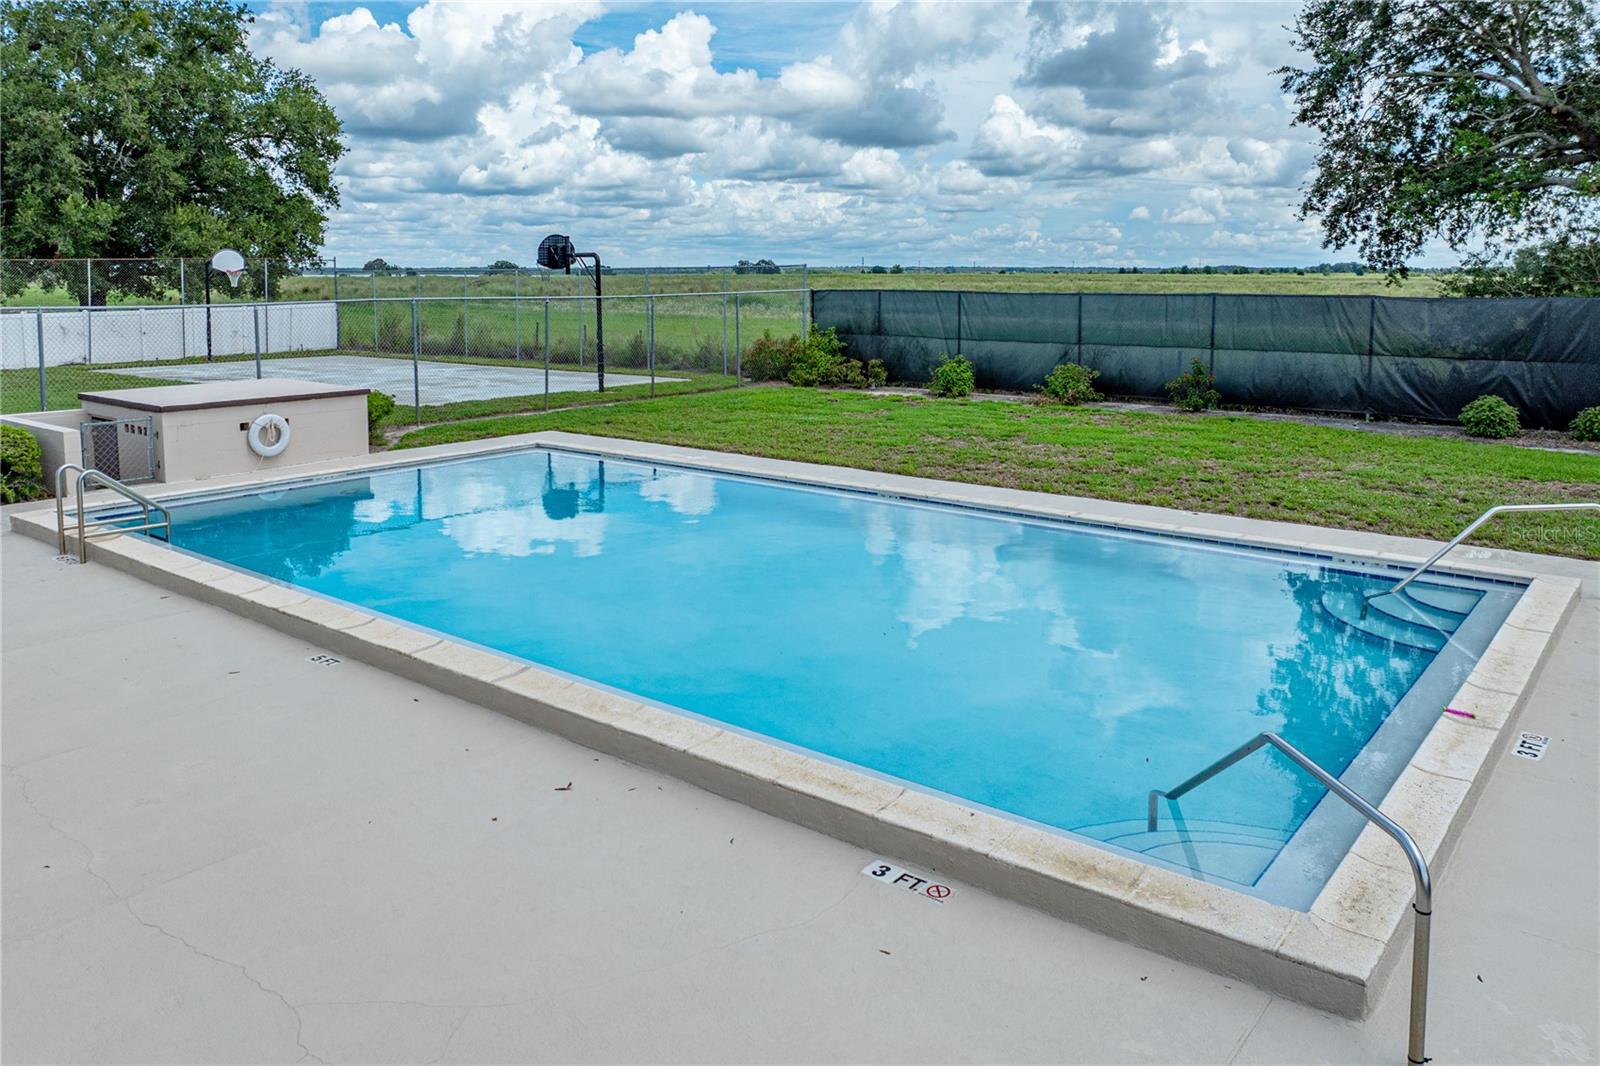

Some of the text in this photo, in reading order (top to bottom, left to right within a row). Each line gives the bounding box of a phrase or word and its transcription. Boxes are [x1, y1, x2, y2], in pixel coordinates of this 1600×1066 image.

[1516, 750, 1539, 758] 3
[871, 865, 928, 892] 3 FT.
